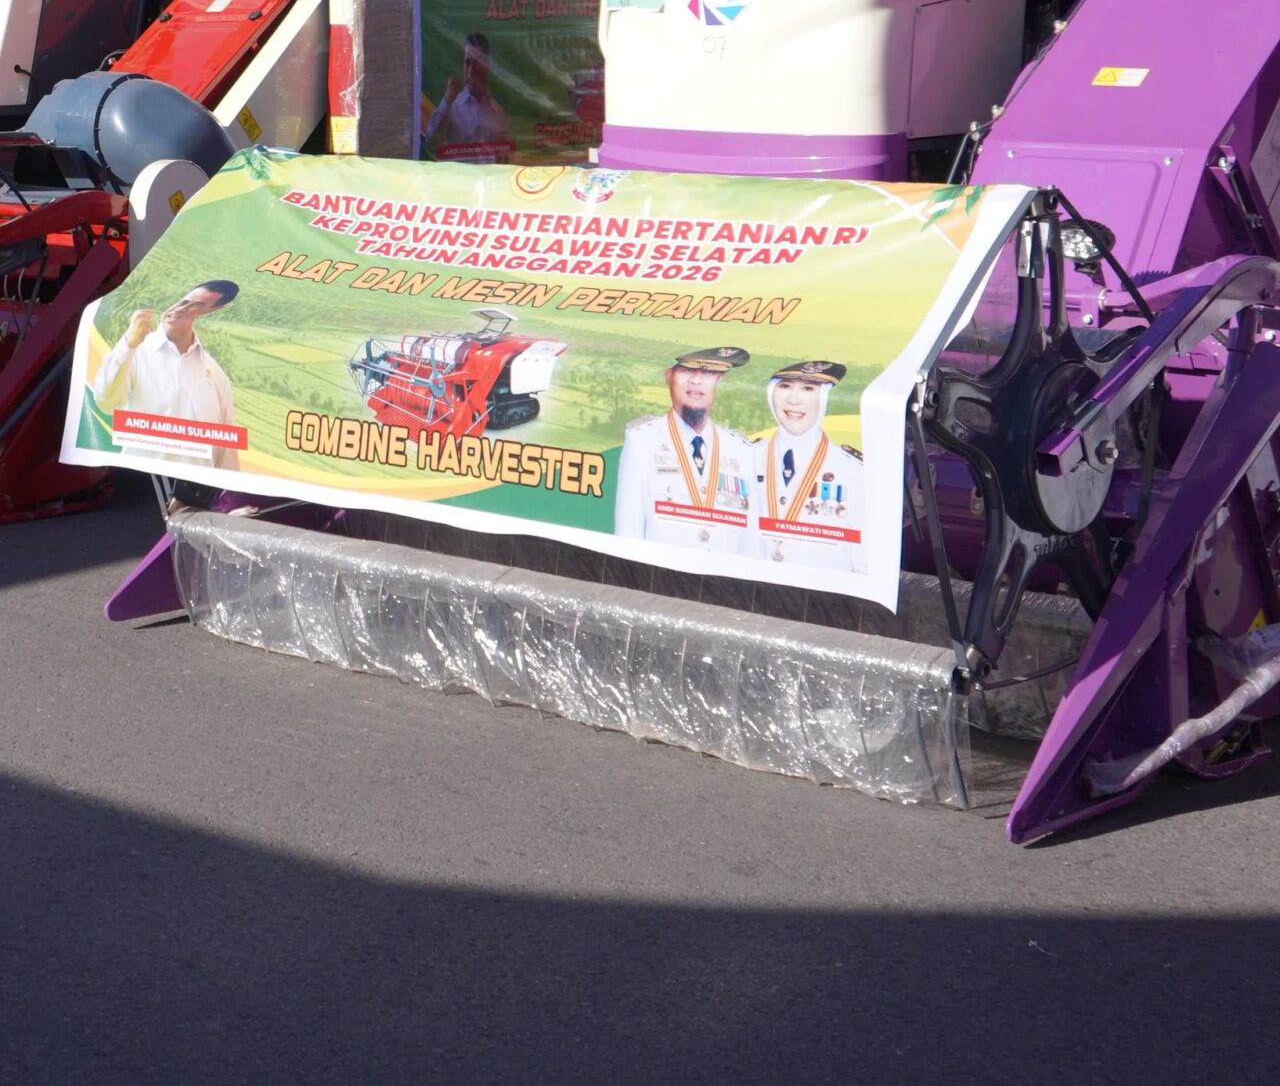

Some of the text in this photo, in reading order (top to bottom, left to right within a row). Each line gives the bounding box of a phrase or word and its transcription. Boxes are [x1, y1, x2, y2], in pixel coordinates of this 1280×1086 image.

[282, 191, 418, 222] BANTUAN
[420, 205, 629, 238] KEMENTERIAN
[634, 218, 829, 246] PERTANIAN
[311, 215, 803, 264] KE PROVINSI SULAWESI SELATAN
[356, 239, 723, 282] TAHUN ANGGARAN 2026
[255, 251, 803, 325] ALAT DAN MESIN PERTANIAN
[125, 417, 238, 443] ANDI AMRAN SULAIMAN
[285, 410, 606, 498] COMBINE HARVESTER
[657, 504, 674, 512] ANDI
[775, 522, 822, 535] FATMAWATI
